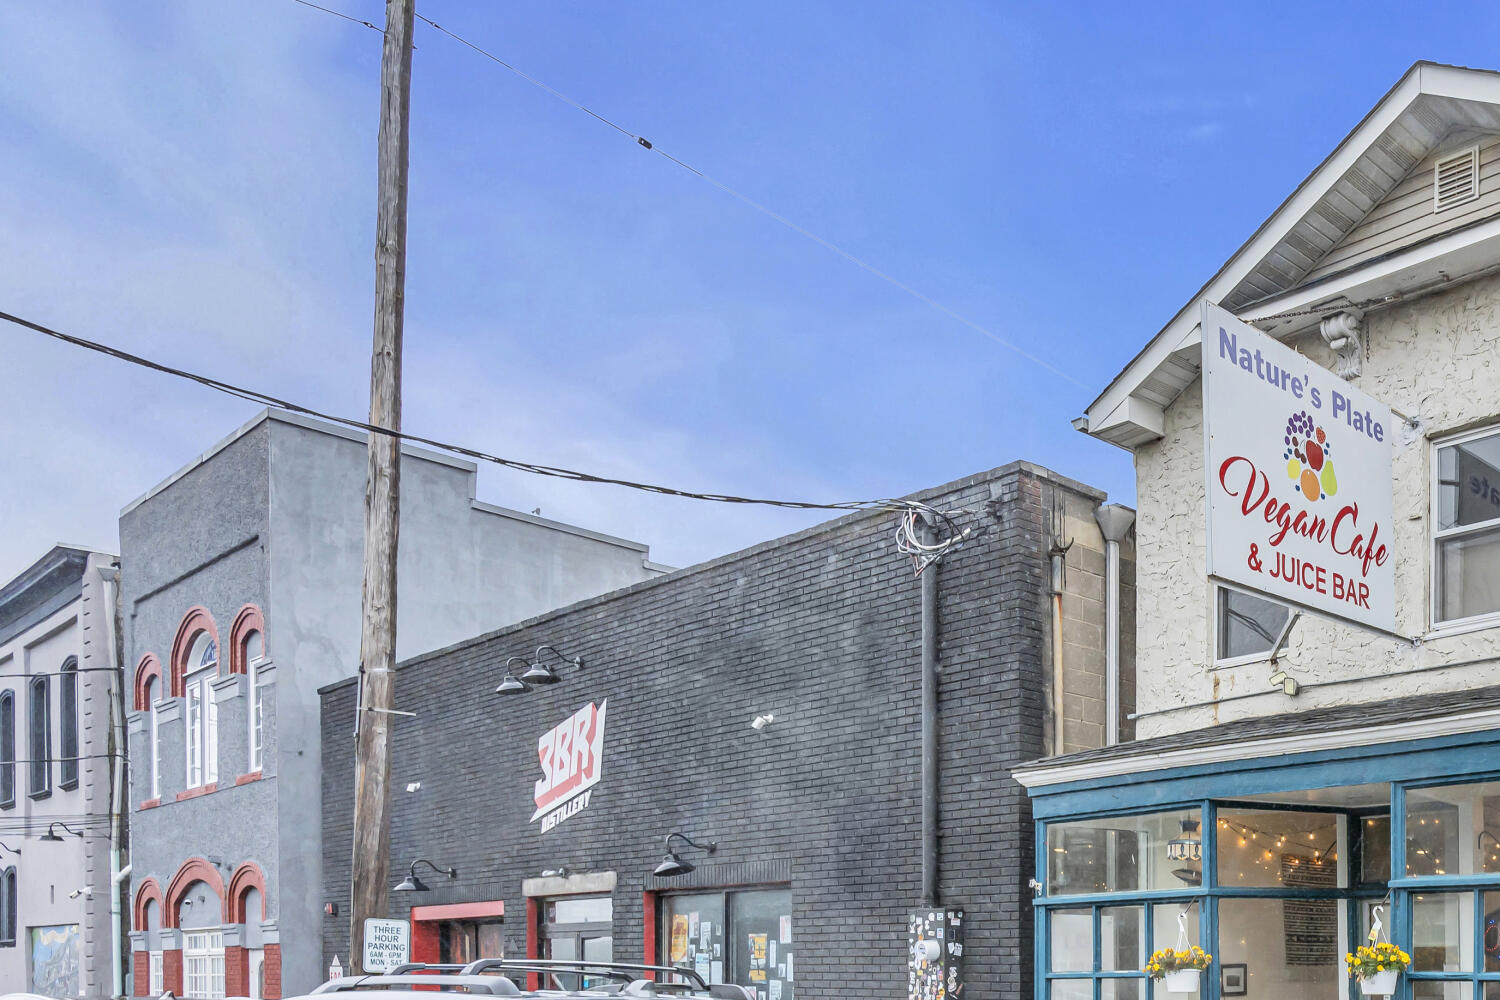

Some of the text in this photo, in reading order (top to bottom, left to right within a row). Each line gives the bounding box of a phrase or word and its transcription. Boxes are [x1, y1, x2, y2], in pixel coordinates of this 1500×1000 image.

[1218, 326, 1384, 442] Nature's Plate
[1219, 455, 1389, 577] Vegan Cafe
[1247, 542, 1371, 610] & JUICE BAR
[541, 789, 593, 834] DISTILLERY
[368, 942, 405, 952] PARKING
[374, 926, 402, 935] THREE
[375, 934, 399, 943] HOUR
